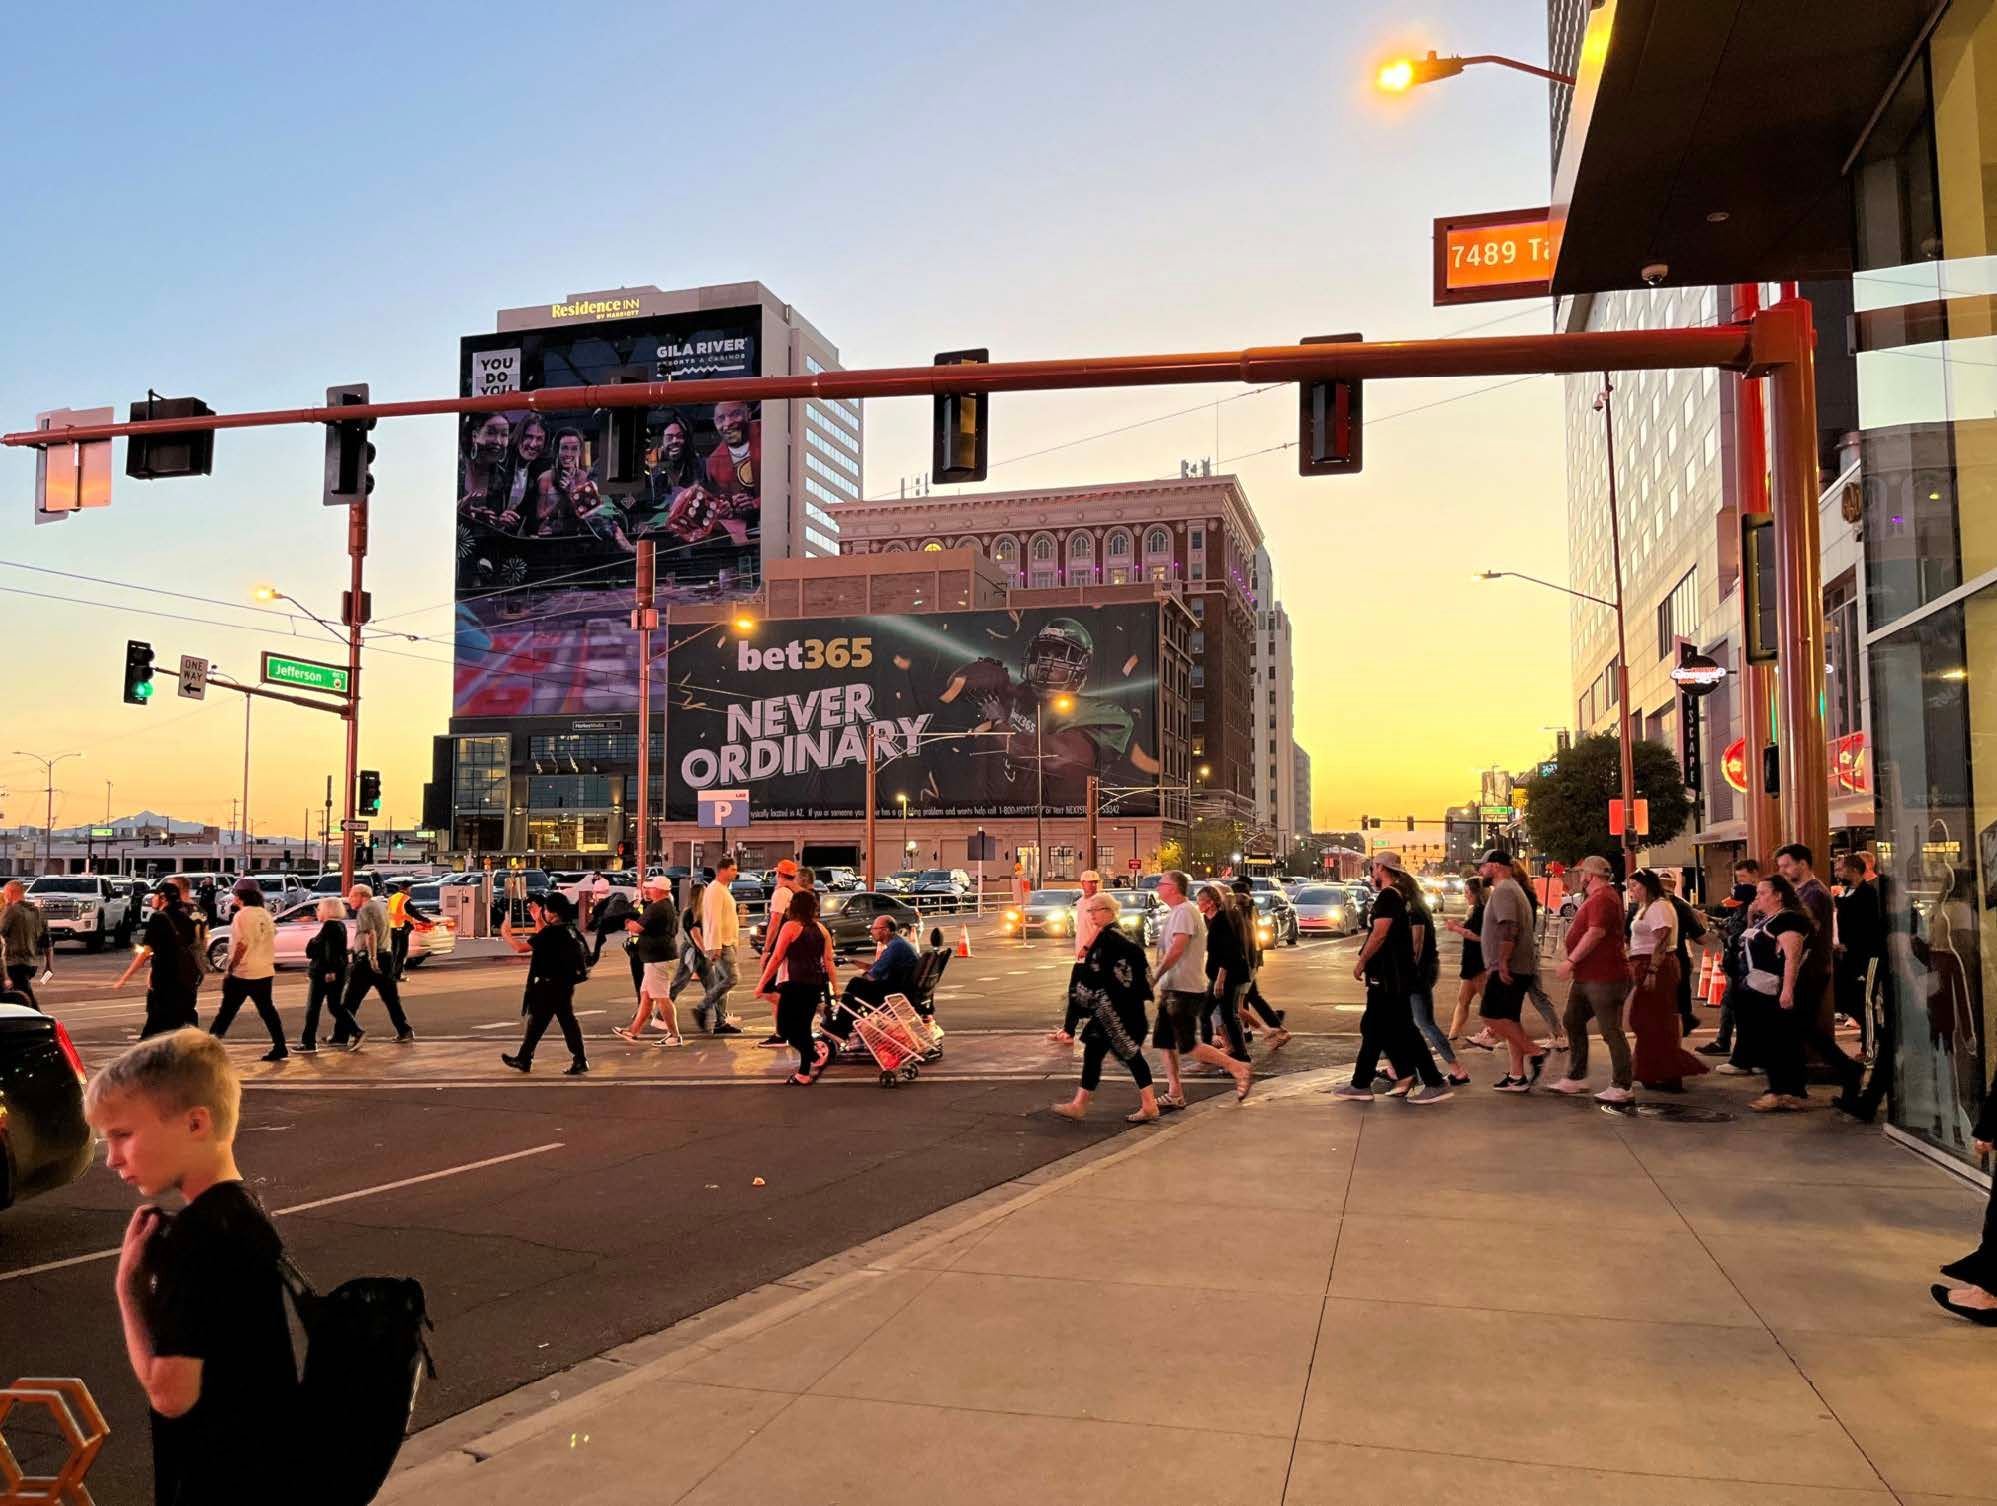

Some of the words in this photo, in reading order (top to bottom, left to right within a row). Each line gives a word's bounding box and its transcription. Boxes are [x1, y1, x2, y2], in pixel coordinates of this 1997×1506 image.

[1451, 240, 1516, 269] 7489
[552, 300, 621, 319] Residence
[623, 298, 640, 310] INN
[606, 310, 640, 319] MARRIOTT
[656, 343, 694, 358] GILA
[696, 338, 745, 354] RIVER
[481, 357, 514, 371] YOU
[485, 371, 508, 384] DO
[738, 637, 873, 671] bet365
[185, 659, 203, 671] ONE
[275, 663, 322, 682] Jefferson
[183, 671, 202, 681] WAY
[727, 683, 876, 744] NEVER
[681, 713, 934, 789] ORDINARY
[714, 800, 733, 826] P
